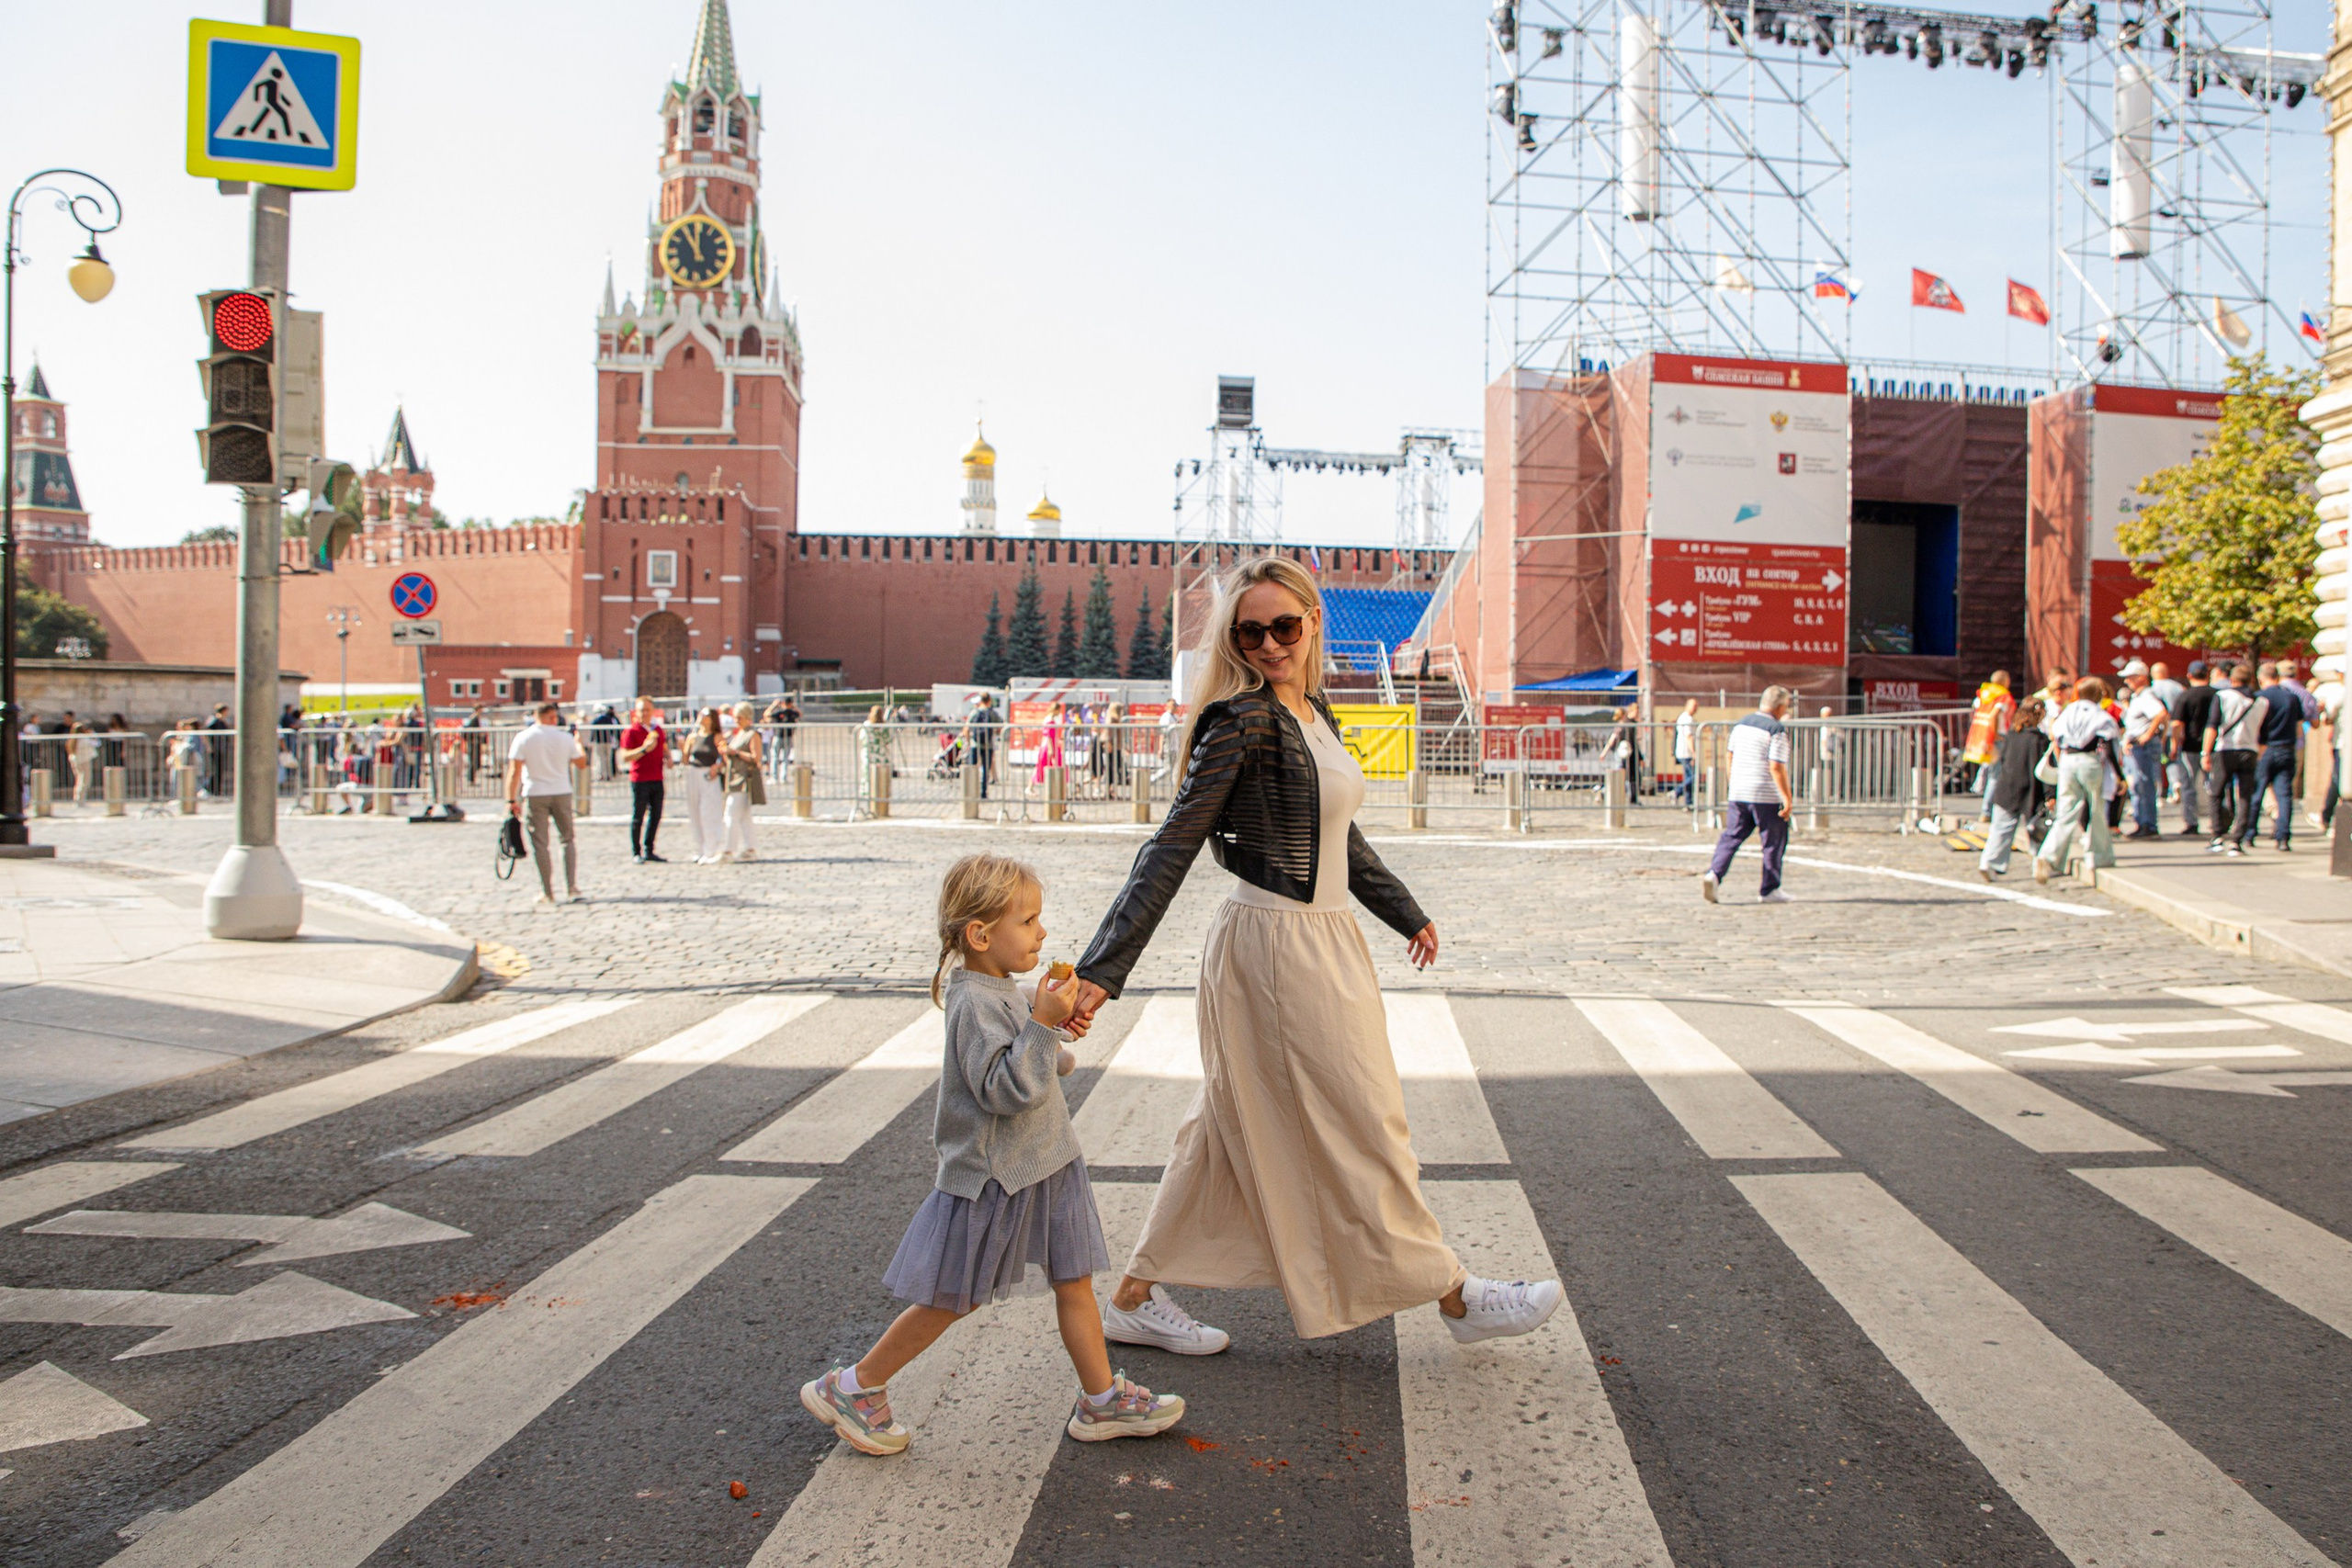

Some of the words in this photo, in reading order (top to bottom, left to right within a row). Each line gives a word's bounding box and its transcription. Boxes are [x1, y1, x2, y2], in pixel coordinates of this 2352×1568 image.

[1694, 566, 1741, 587] ВХОД
[1746, 568, 1759, 579] на
[1762, 569, 1800, 582] сектор
[1733, 611, 1751, 623] VIP
[1875, 682, 1920, 703] ВХОД
